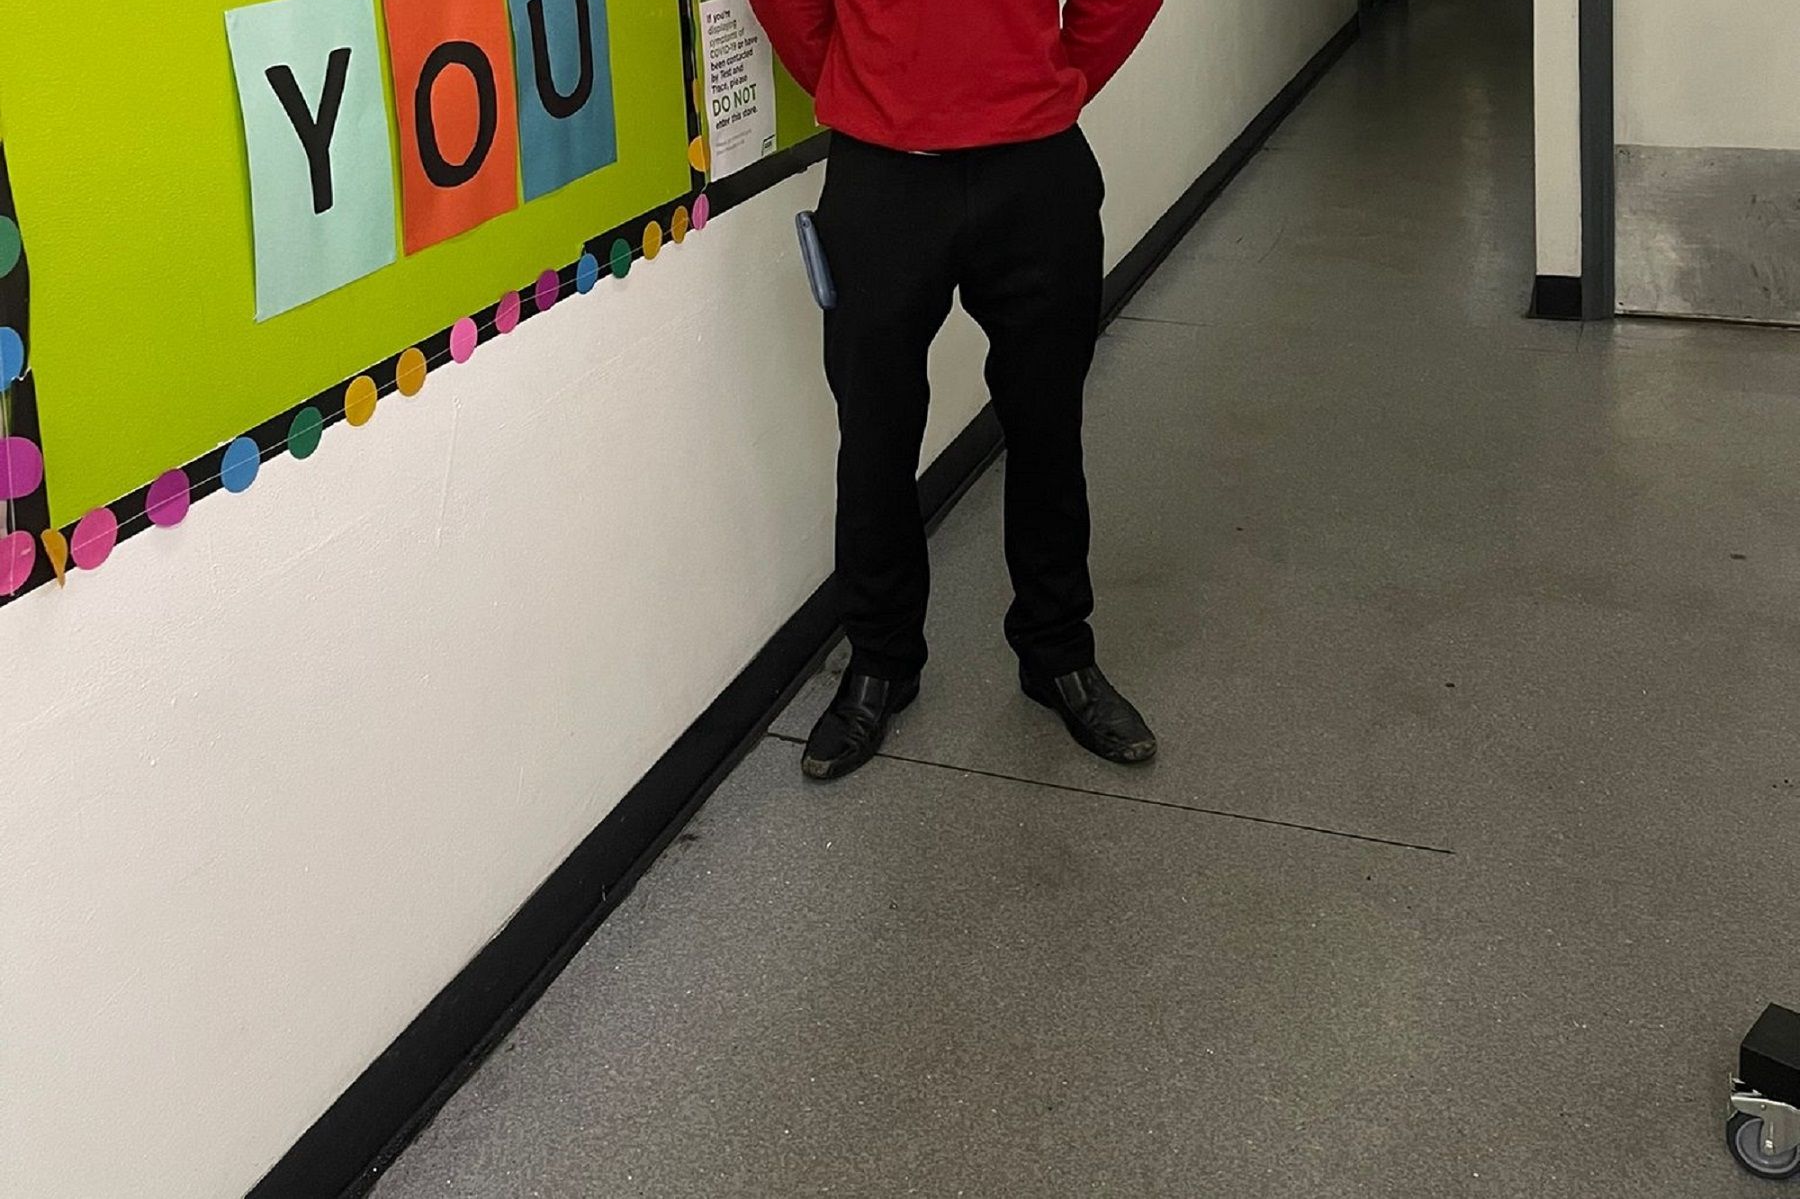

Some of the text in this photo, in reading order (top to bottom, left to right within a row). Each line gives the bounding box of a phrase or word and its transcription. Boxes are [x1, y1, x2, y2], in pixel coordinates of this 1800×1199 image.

[706, 13, 712, 23] If
[737, 40, 744, 50] or
[744, 36, 758, 47] have
[711, 49, 753, 71] been contacted
[711, 64, 744, 84] by Test and
[730, 74, 748, 89] please
[712, 84, 757, 117] DO NOT
[716, 117, 730, 130] enter
[731, 112, 741, 123] this
